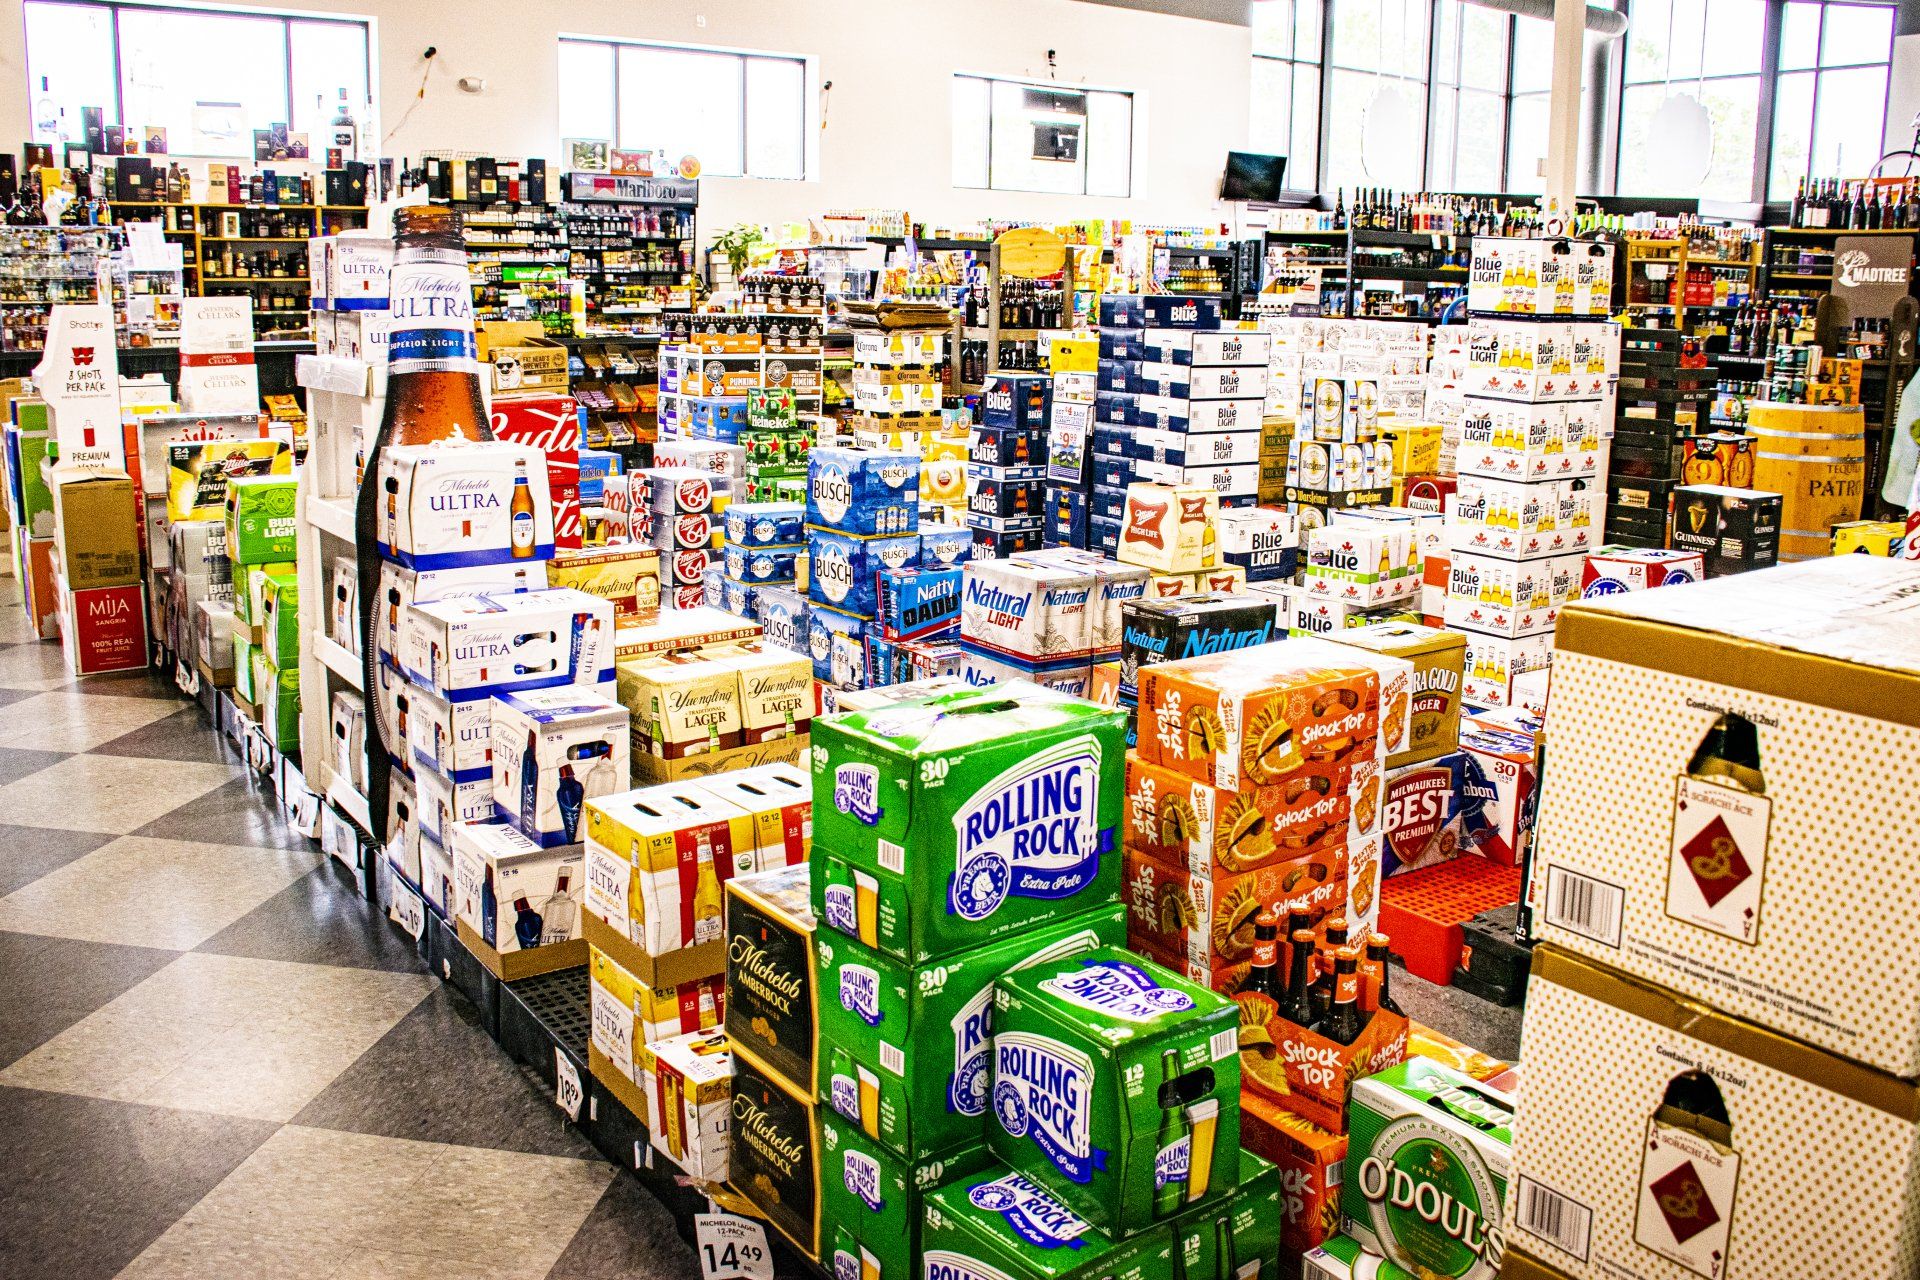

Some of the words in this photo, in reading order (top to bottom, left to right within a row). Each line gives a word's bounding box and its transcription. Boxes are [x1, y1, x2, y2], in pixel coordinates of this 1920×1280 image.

[615, 178, 677, 199] Marlboro
[343, 264, 385, 275] ULTRA
[1474, 256, 1502, 271] Blue
[1473, 271, 1502, 283] LIGHT
[1852, 266, 1907, 283] MADTREE
[197, 311, 241, 321] CELLARS
[392, 297, 472, 320] ULTRA
[1170, 306, 1198, 321] Blue
[857, 342, 878, 352] Corona
[1222, 341, 1242, 352] Blue
[1470, 351, 1498, 364] LIGHT
[1717, 355, 1750, 363] BROOKLYN
[77, 369, 101, 380] SHOTS
[730, 377, 757, 386] PUMKING
[791, 377, 816, 387] PUMKING
[66, 382, 84, 392] PER
[85, 381, 105, 392] PACK
[856, 390, 877, 400] Corona
[1464, 430, 1491, 443] LIGHT
[72, 451, 110, 462] PREMIUM
[882, 466, 908, 480] BUSCH
[1827, 463, 1862, 474] TEQUILA
[687, 488, 706, 506] 64
[813, 478, 852, 506] BUSCH
[430, 493, 500, 511] ULTRA
[1409, 501, 1438, 512] KILLIAN'S
[269, 518, 296, 528] BUD
[1130, 526, 1145, 537] HIGH
[1144, 528, 1159, 539] LIFE
[1754, 526, 1775, 534] GUINNESS
[687, 524, 706, 542] 64
[1252, 532, 1283, 550] Blue
[1674, 531, 1717, 546] GUINNESS
[562, 559, 588, 567] BREWING
[589, 556, 605, 564] GOOD
[607, 554, 623, 562] TIMES
[625, 552, 641, 560] SINCE
[882, 548, 908, 561] BUSCH
[1251, 550, 1282, 567] LIGHT
[816, 558, 853, 588] BUSCH
[1452, 568, 1480, 585] Blue
[1628, 566, 1642, 577] 12
[917, 578, 956, 604] Natty
[966, 577, 1032, 618] Natural
[1042, 587, 1090, 606] Natural
[1100, 580, 1147, 601] Natural
[1452, 584, 1479, 597] LIGHT
[96, 618, 127, 626] SANGRIA
[987, 610, 1023, 631] LIGHT
[763, 617, 796, 645] BUSCH
[1124, 625, 1169, 652] Natural
[1182, 620, 1271, 659] Natural
[114, 637, 134, 646] REAL
[616, 645, 649, 656] REWING
[652, 641, 676, 651] GOOD
[679, 636, 705, 647] TIMES
[708, 633, 733, 643] SINCE
[735, 629, 755, 639] 1829
[455, 643, 511, 660] ULTRA
[1146, 652, 1165, 662] ICE
[748, 672, 810, 696] Yuengling
[1429, 667, 1458, 693] GOLD
[669, 689, 734, 712] Yuengling
[761, 698, 802, 715] LAGER
[1686, 697, 1725, 715] Contains
[684, 712, 727, 729] LAGER
[1155, 703, 1170, 748] TOP
[1165, 688, 1185, 760] SHOCK
[1301, 721, 1342, 746] SHOCK
[1343, 711, 1365, 731] TOP
[920, 757, 949, 782] 30
[1494, 761, 1516, 777] 30
[838, 771, 872, 793] ROLLING
[924, 779, 946, 789] PACK
[1390, 777, 1445, 800] MILWAUKEE'S
[1680, 781, 1688, 798] A
[850, 788, 872, 809] ROCK
[965, 765, 1082, 853] ROLLING
[1130, 789, 1144, 835] TOP
[1141, 776, 1158, 846] SHOCK
[1273, 806, 1313, 832] SHOCK
[1313, 798, 1337, 818] TOP
[1383, 790, 1454, 834] BEST
[1733, 804, 1753, 817] ACE
[1012, 816, 1082, 861] ROCK
[1395, 823, 1435, 842] PREMIUM
[588, 865, 622, 900] ULTRA
[961, 858, 1001, 892] PREMIUM
[1020, 873, 1051, 890] Extra
[1051, 874, 1082, 891] Pale
[974, 891, 1000, 911] BEER
[729, 934, 803, 1000] Michelob
[842, 970, 874, 996] ROLLING
[919, 966, 948, 991] 30
[738, 969, 791, 1017] AMBERBOCK
[853, 989, 873, 1011] ROCK
[922, 987, 943, 998] PACK
[1776, 989, 1804, 1005] Brooklyn
[1282, 1039, 1342, 1068] SHOCK
[1124, 1063, 1145, 1082] 12
[1656, 1045, 1694, 1067] Contains
[1706, 1065, 1747, 1088] (4x12oz)
[1000, 1046, 1078, 1111] ROLLING
[1296, 1063, 1335, 1090] TOP
[1028, 1086, 1076, 1149] ROCK
[732, 1093, 803, 1163] Michelob
[741, 1127, 792, 1177] AMBERBOCK
[1034, 1129, 1056, 1157] Extra
[1056, 1153, 1079, 1176] Pale
[1704, 1153, 1723, 1168] ACE
[846, 1155, 875, 1184] ROLLING
[914, 1161, 944, 1185] 30
[1377, 1122, 1416, 1157] PREMIUM
[1431, 1125, 1469, 1157] EXTRA
[1469, 1161, 1497, 1222] SMOOTH
[918, 1180, 939, 1191] PACK
[926, 1205, 942, 1226] 12
[1358, 1156, 1506, 1272] O'DOUL'S
[700, 1220, 737, 1228] MICHELOB
[717, 1227, 745, 1237] 12-PACK
[1182, 1234, 1201, 1253] 12
